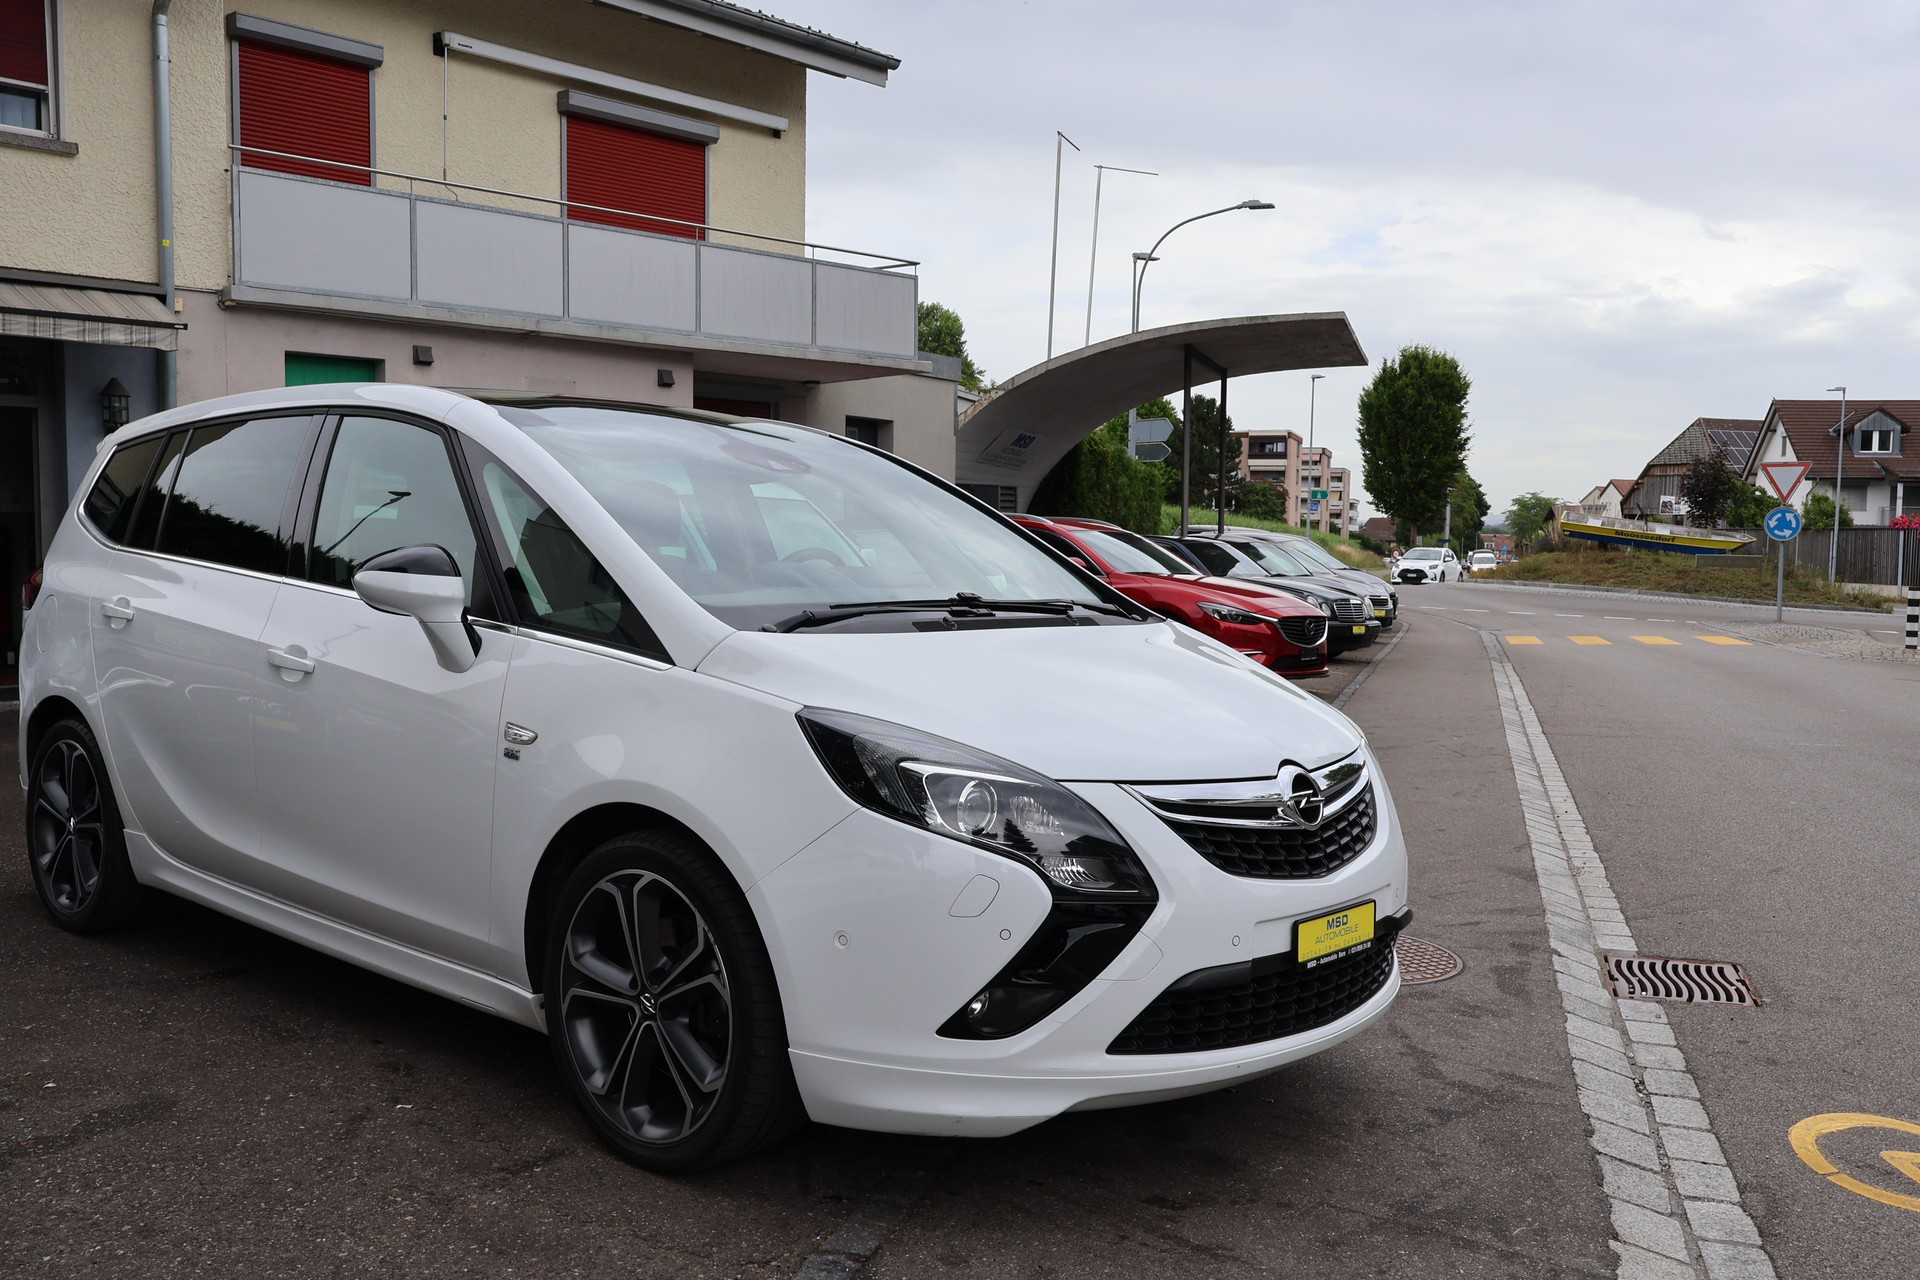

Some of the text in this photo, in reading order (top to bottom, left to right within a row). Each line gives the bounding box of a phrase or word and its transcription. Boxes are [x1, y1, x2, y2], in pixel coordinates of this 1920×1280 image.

[1614, 530, 1676, 543] Moosseedorf
[1327, 914, 1349, 931] MSD
[1315, 924, 1359, 945] AUTOMOBILE
[1301, 945, 1332, 960] OCCASION
